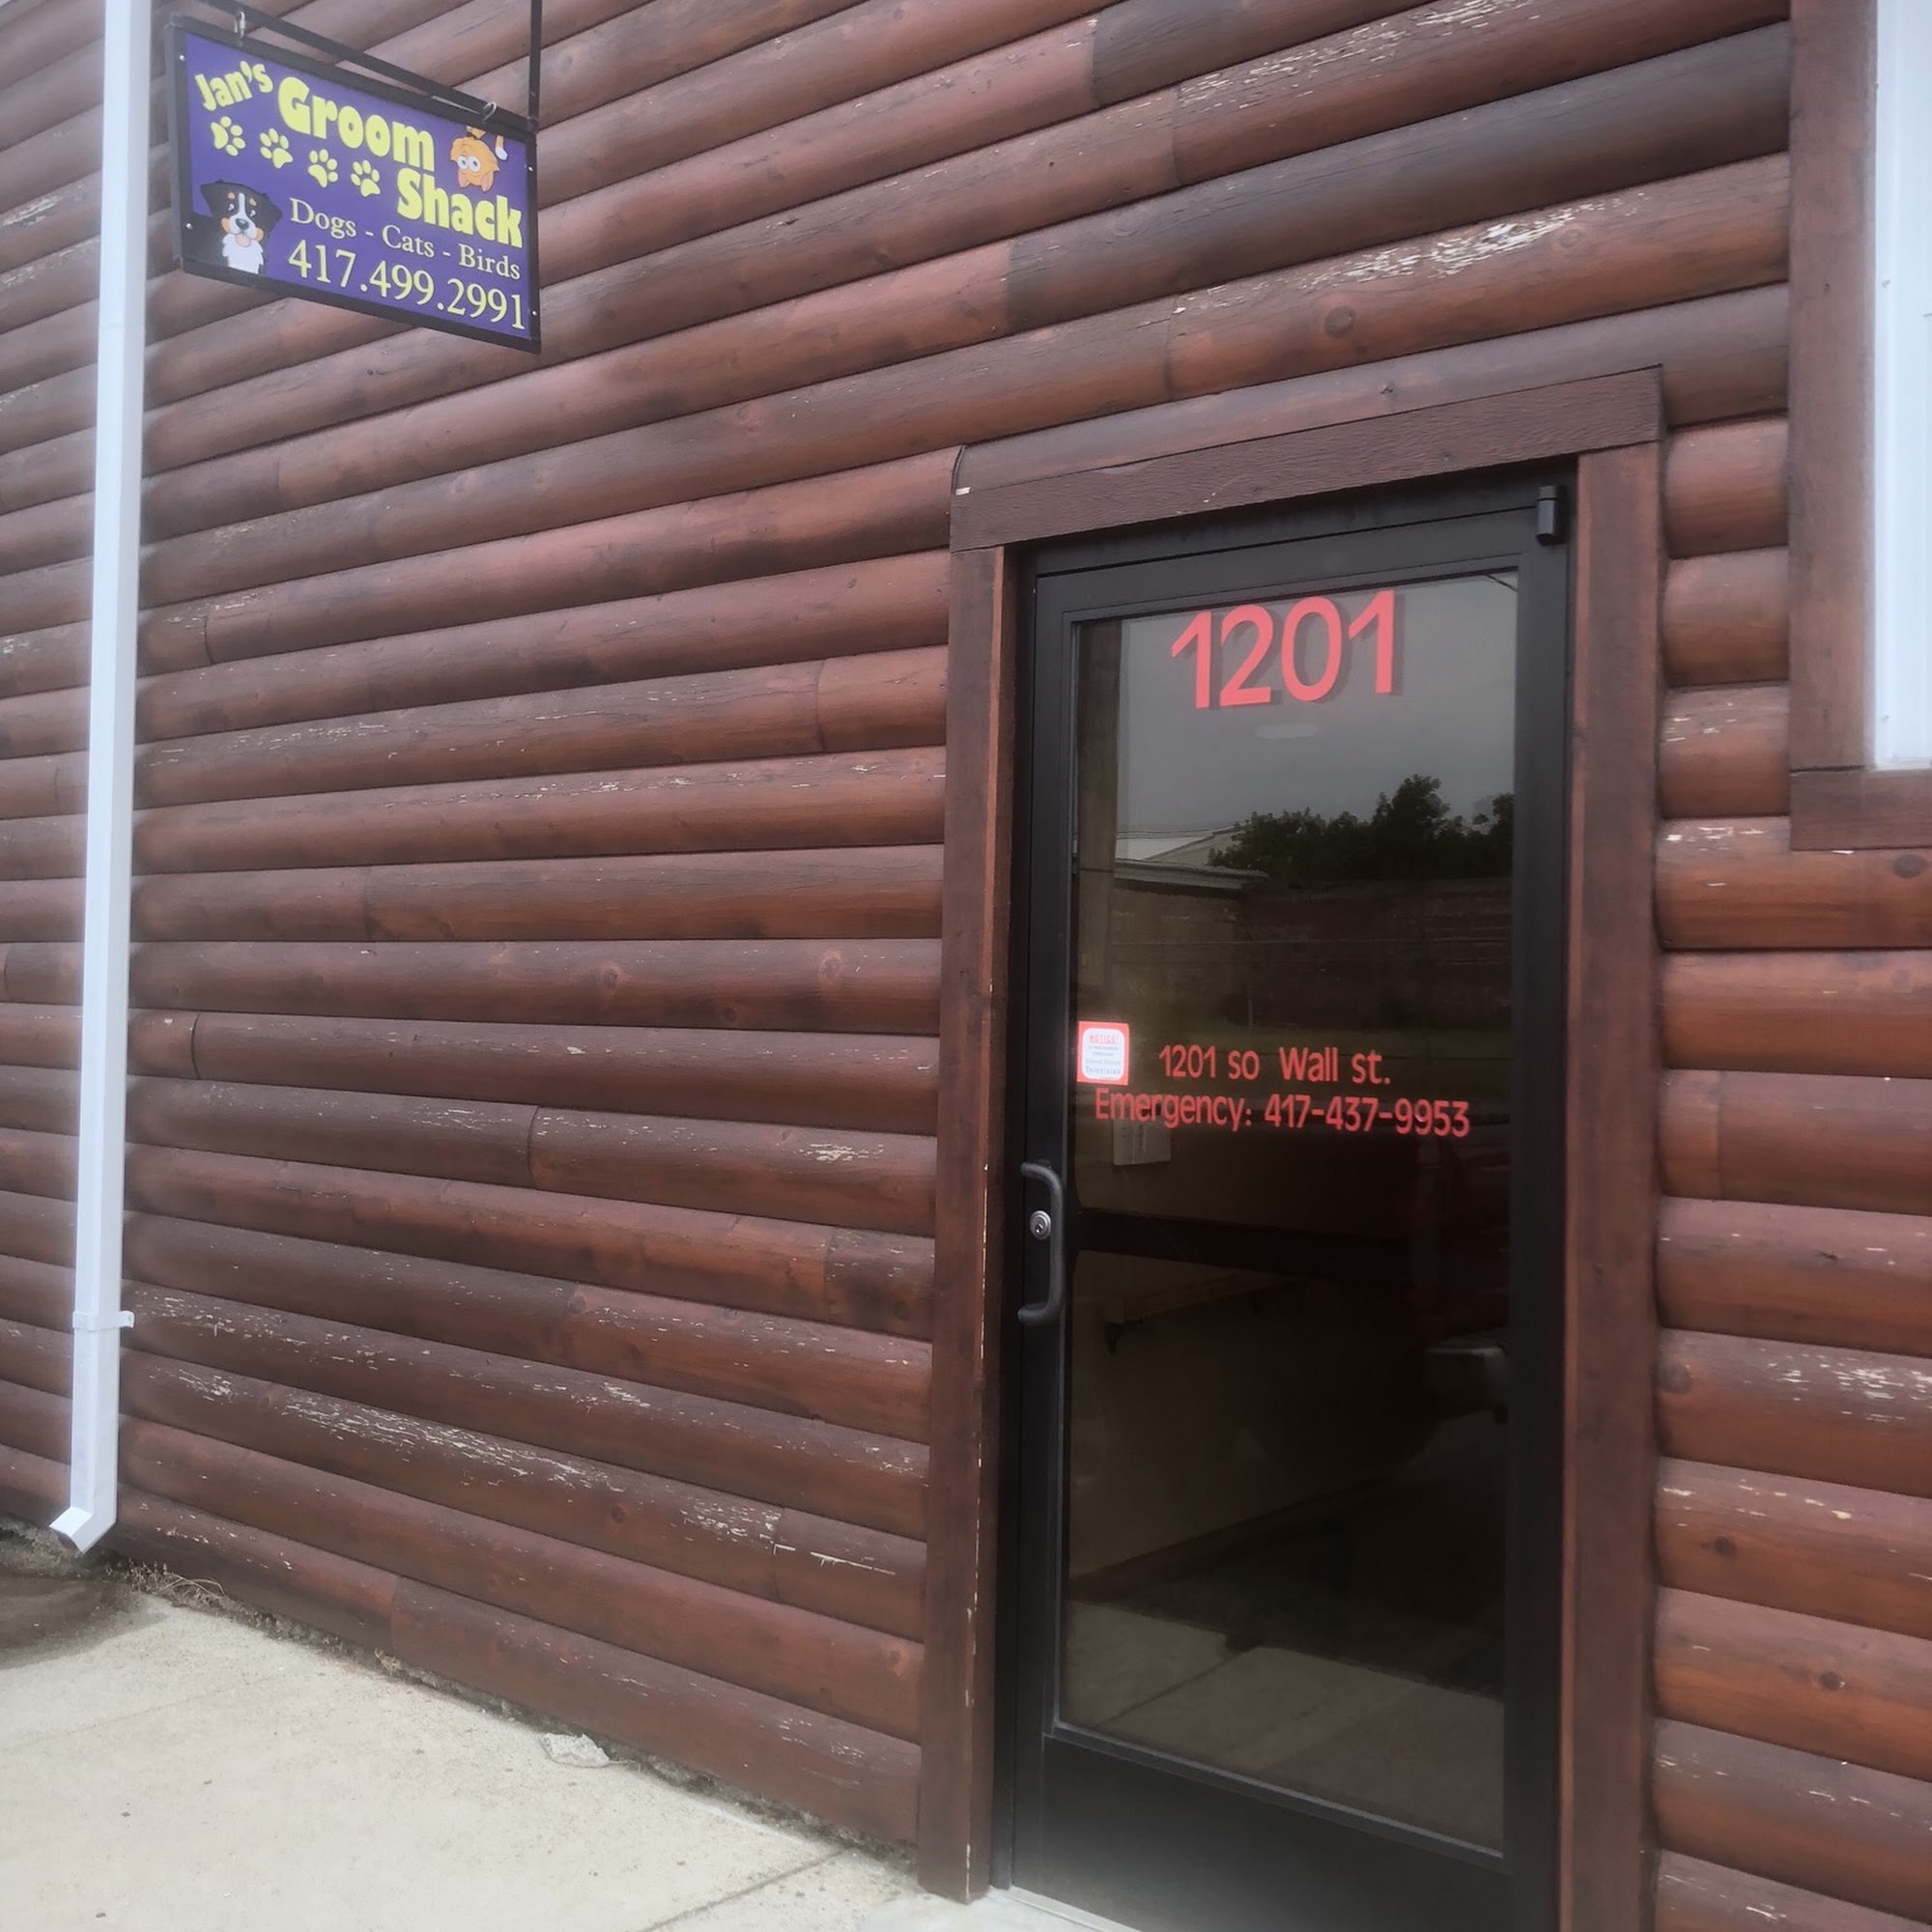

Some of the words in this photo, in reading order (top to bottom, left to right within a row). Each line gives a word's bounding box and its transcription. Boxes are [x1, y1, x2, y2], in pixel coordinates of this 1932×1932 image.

[195, 61, 273, 111] Jan's
[277, 76, 436, 172] Groom
[290, 197, 356, 240] Dogs
[382, 224, 434, 258] Cats
[458, 243, 520, 280] Birds
[397, 167, 524, 248] Shack
[288, 239, 525, 329] 417.499.2991
[1171, 589, 1395, 709] 1201
[1159, 1044, 1217, 1078] 1201
[1228, 1050, 1260, 1080] so
[1279, 1046, 1339, 1082] Wall
[1351, 1049, 1391, 1085] st.
[1094, 1088, 1252, 1131] Emergency:
[1264, 1094, 1470, 1138] 417-437-9953
